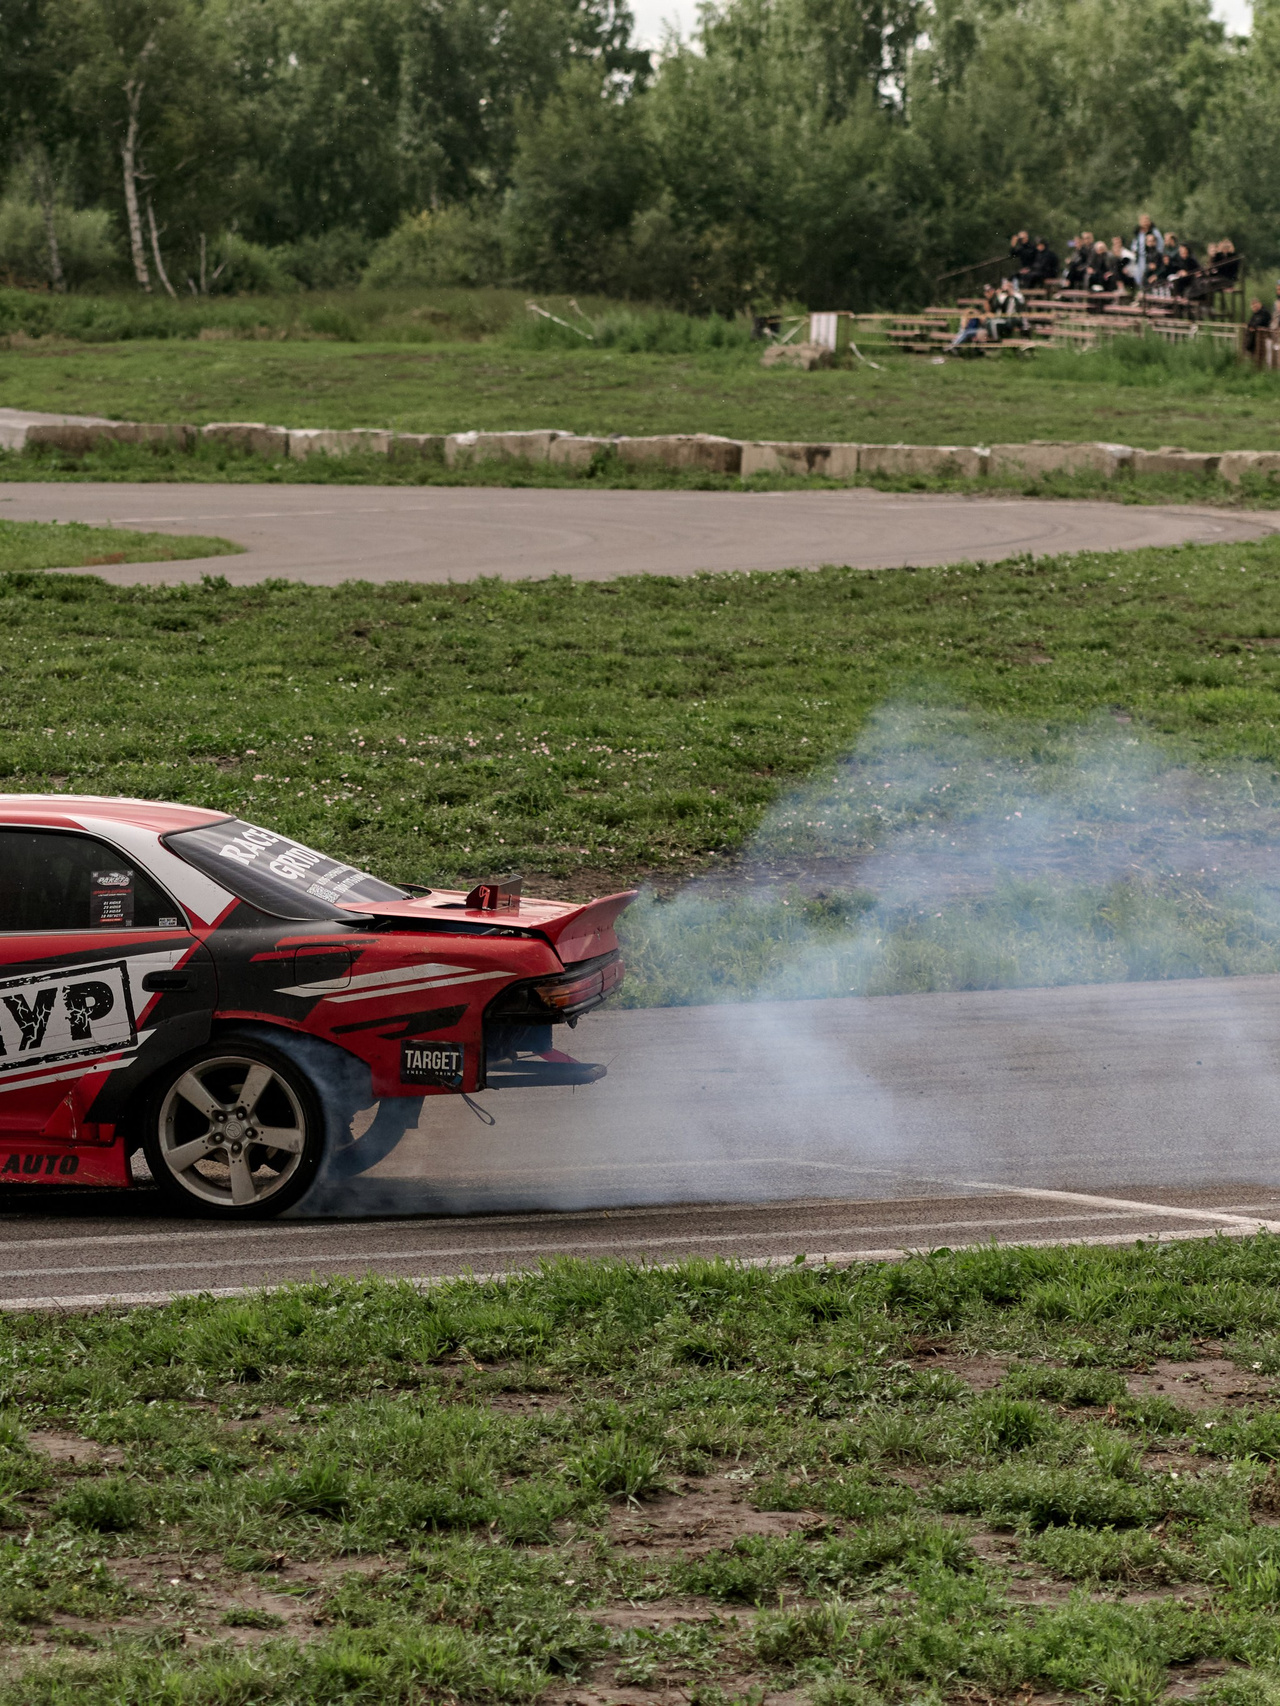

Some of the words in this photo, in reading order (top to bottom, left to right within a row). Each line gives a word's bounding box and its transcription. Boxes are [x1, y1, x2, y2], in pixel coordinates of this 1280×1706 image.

[218, 828, 279, 865] RACE
[269, 847, 320, 880] GRID
[405, 1050, 459, 1070] TARGET
[1, 1154, 80, 1175] AUTO
